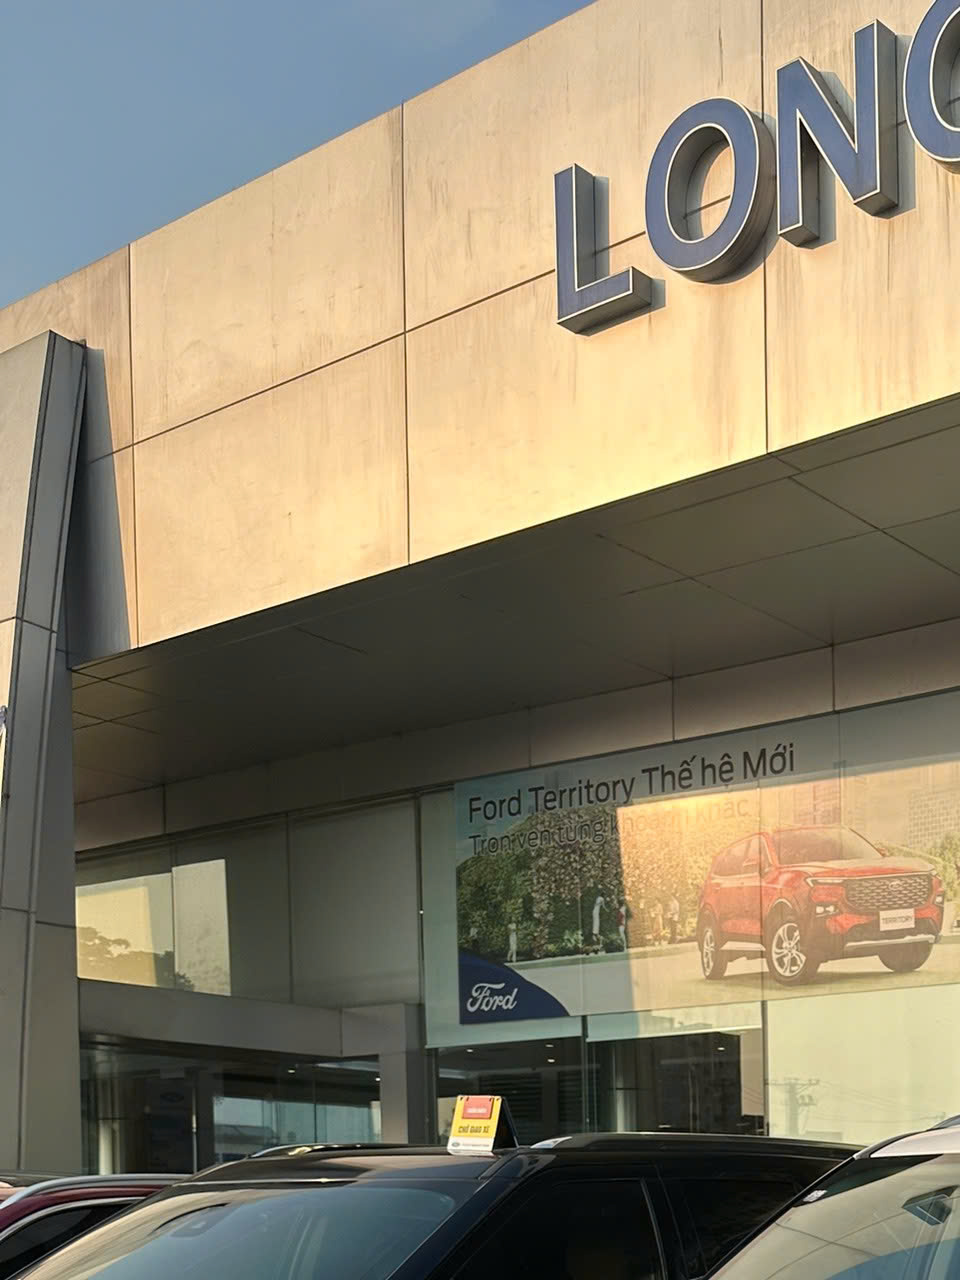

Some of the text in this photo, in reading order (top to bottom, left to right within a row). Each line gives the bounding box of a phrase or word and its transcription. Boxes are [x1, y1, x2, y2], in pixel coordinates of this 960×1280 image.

[468, 742, 794, 823] Ford Territory Thế hệ Mới
[466, 982, 519, 1013] Ford
